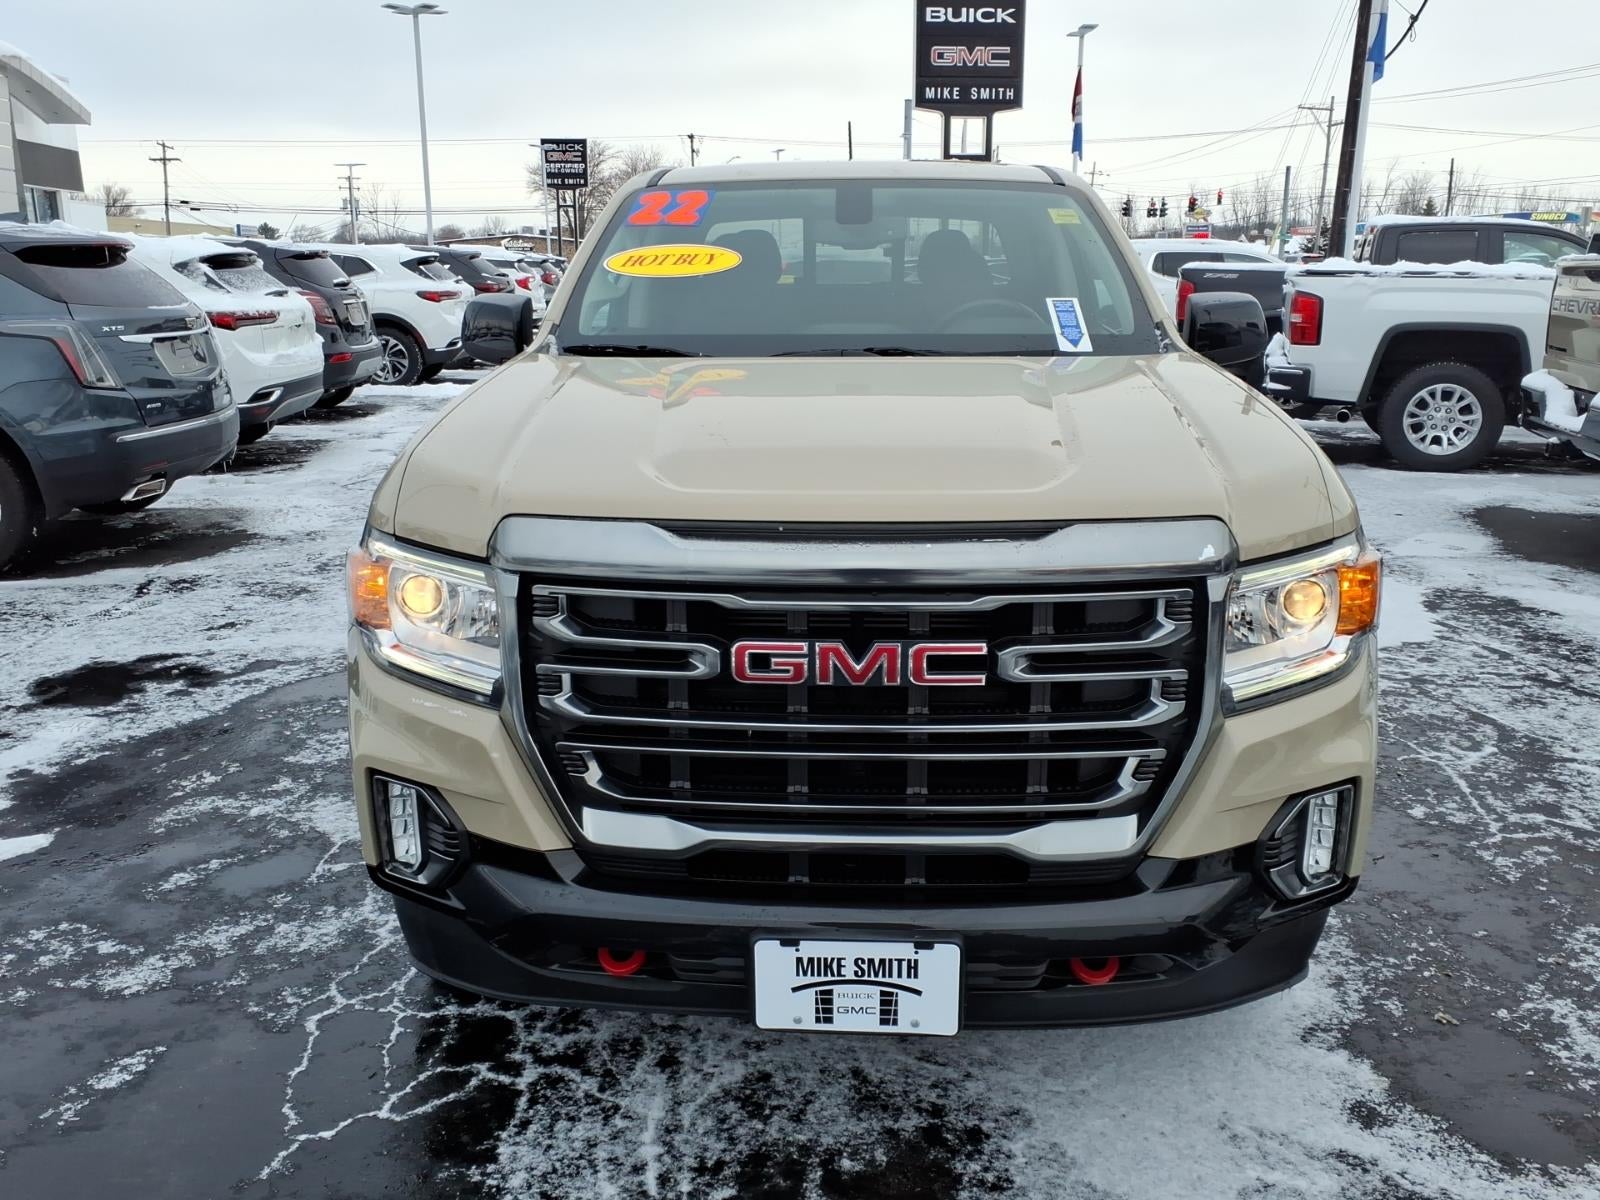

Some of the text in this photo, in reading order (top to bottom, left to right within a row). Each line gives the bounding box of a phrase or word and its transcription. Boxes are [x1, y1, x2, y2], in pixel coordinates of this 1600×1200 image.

[925, 7, 1017, 23] BUICK
[930, 46, 1011, 67] GMC
[925, 87, 1014, 100] MIKE SMITH
[546, 151, 582, 161] GMC
[628, 190, 709, 226] 22
[1530, 211, 1568, 221] SUNOCO
[620, 253, 725, 268] HOT BUY
[731, 641, 988, 686] GMC
[795, 957, 919, 980] MIKE SMITH
[837, 992, 875, 1000] BUICK
[836, 1006, 877, 1015] GMC
